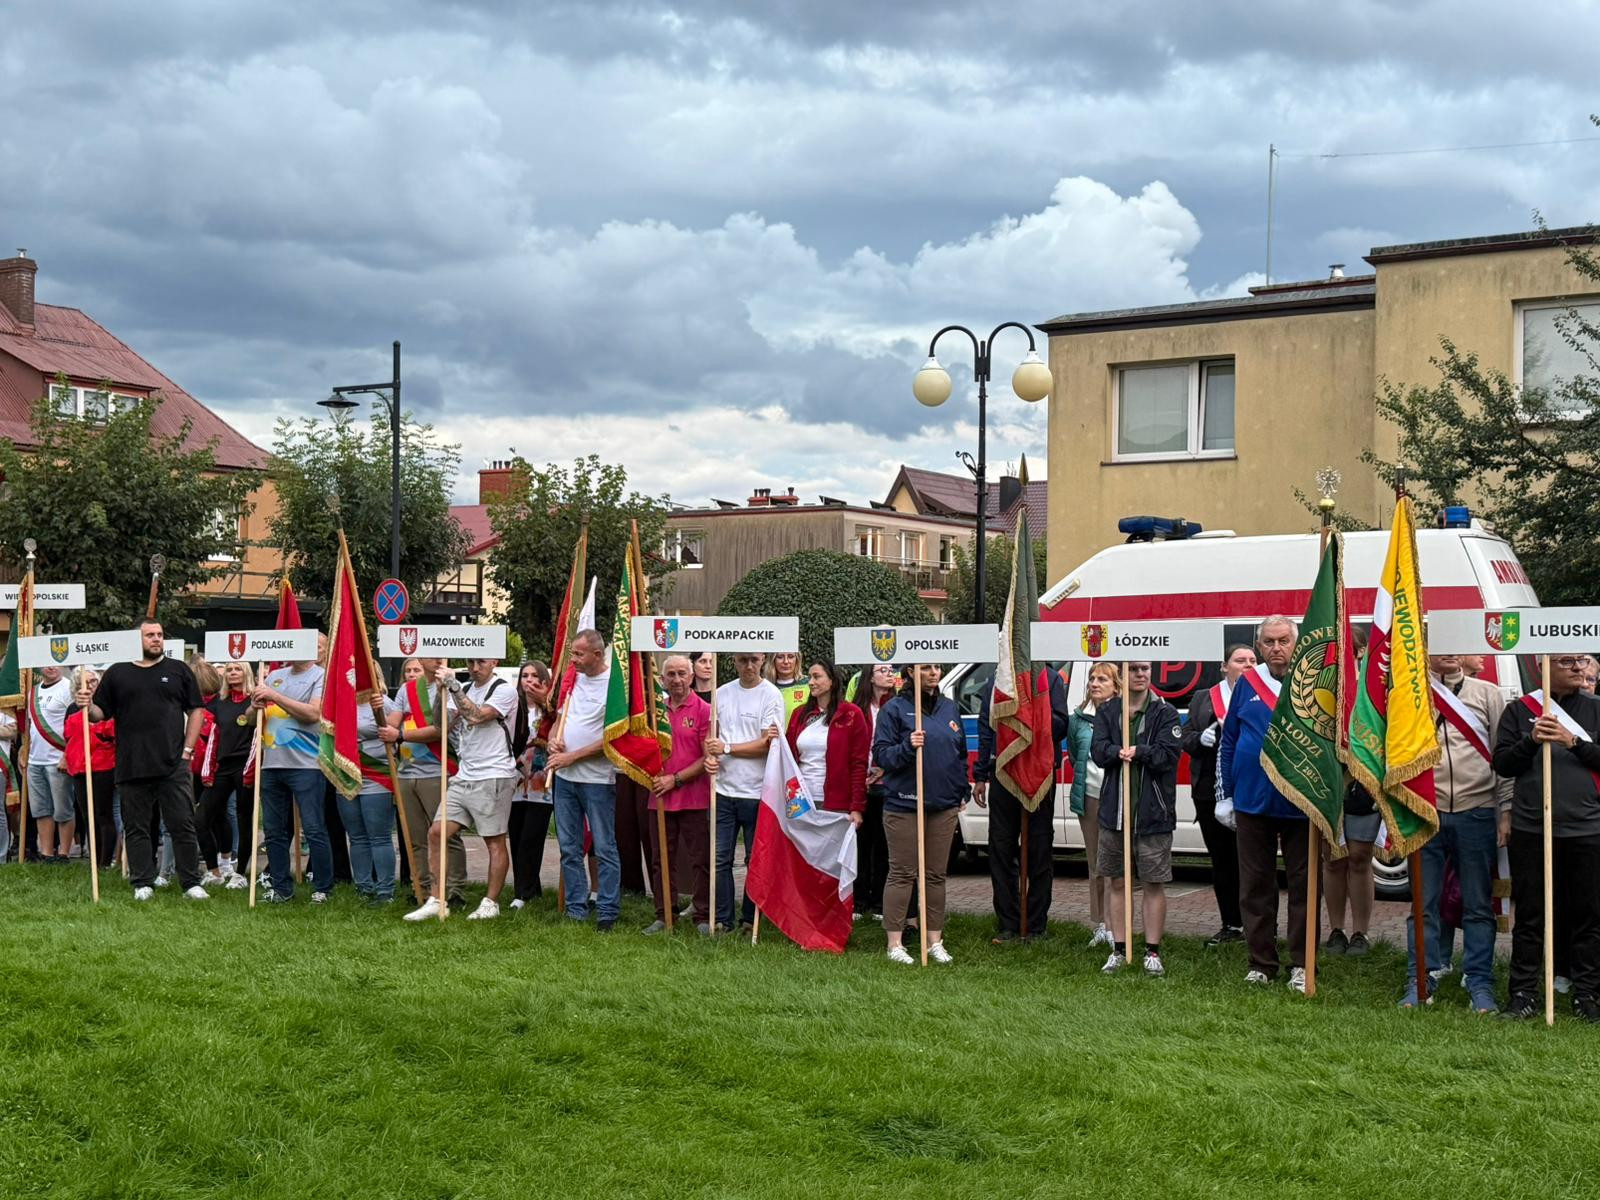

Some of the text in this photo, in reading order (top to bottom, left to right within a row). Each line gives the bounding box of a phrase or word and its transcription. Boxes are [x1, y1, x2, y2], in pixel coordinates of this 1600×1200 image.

[684, 630, 774, 640] PODKARPACKIE
[1530, 624, 1600, 637] LUBUSKI
[251, 640, 294, 650] PODLASKIE
[422, 637, 485, 647] MAZOWIECKIE
[904, 639, 959, 650] OPOLSKIE
[1115, 633, 1170, 647] ŁÓDZKIE
[75, 640, 109, 655] ŚLĄSKIE
